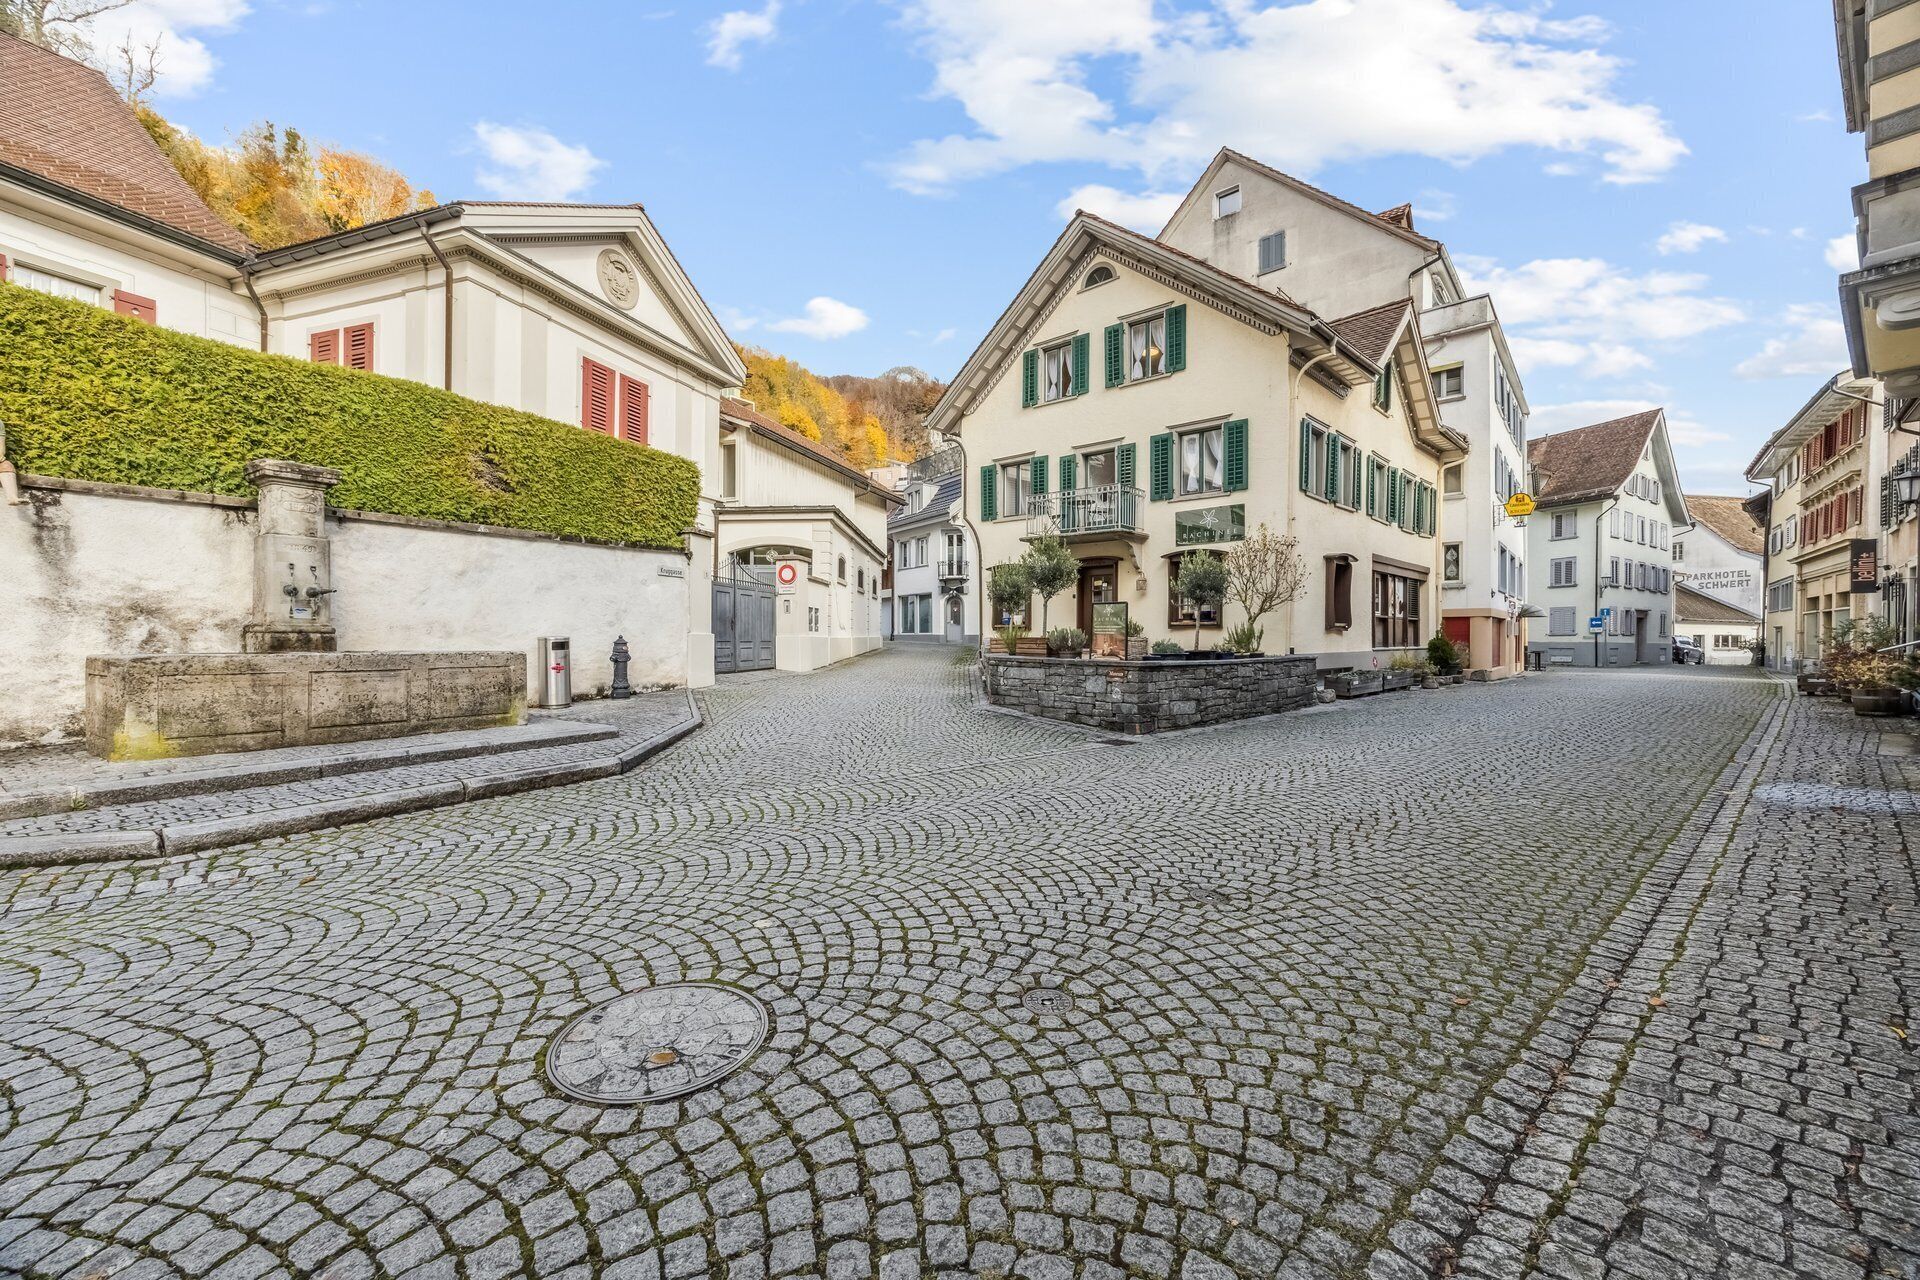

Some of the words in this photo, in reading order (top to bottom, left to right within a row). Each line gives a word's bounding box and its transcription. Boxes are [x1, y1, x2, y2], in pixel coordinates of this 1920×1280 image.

[1182, 528, 1238, 540] RACHINEL
[1686, 569, 1752, 582] PARKHOTEL
[1697, 579, 1752, 590] SCHWERT
